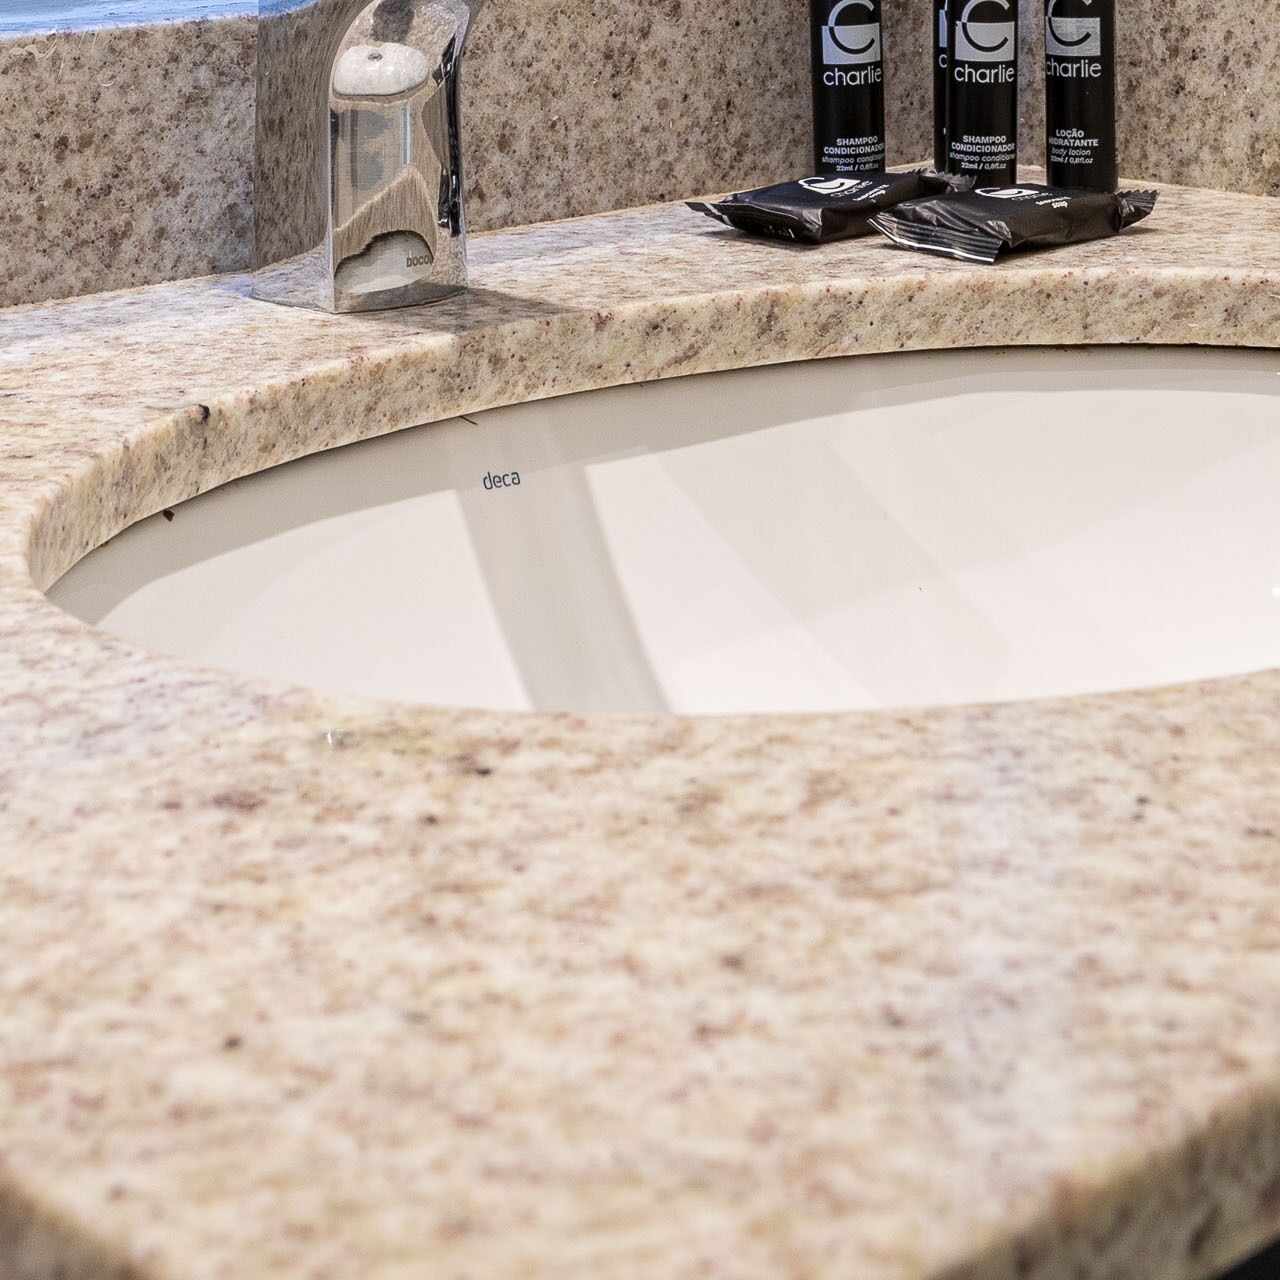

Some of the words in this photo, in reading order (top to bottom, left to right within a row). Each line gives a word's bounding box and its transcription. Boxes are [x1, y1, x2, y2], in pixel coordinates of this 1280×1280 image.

[823, 65, 881, 86] charlie
[954, 64, 1014, 83] charlie
[1046, 58, 1102, 78] charlie
[836, 136, 878, 146] SHAMPOO
[963, 135, 1006, 144] SHAMPOO
[1056, 128, 1084, 139] LOÇÃO
[824, 142, 885, 154] CONDICIONADO
[483, 471, 521, 490] deca
